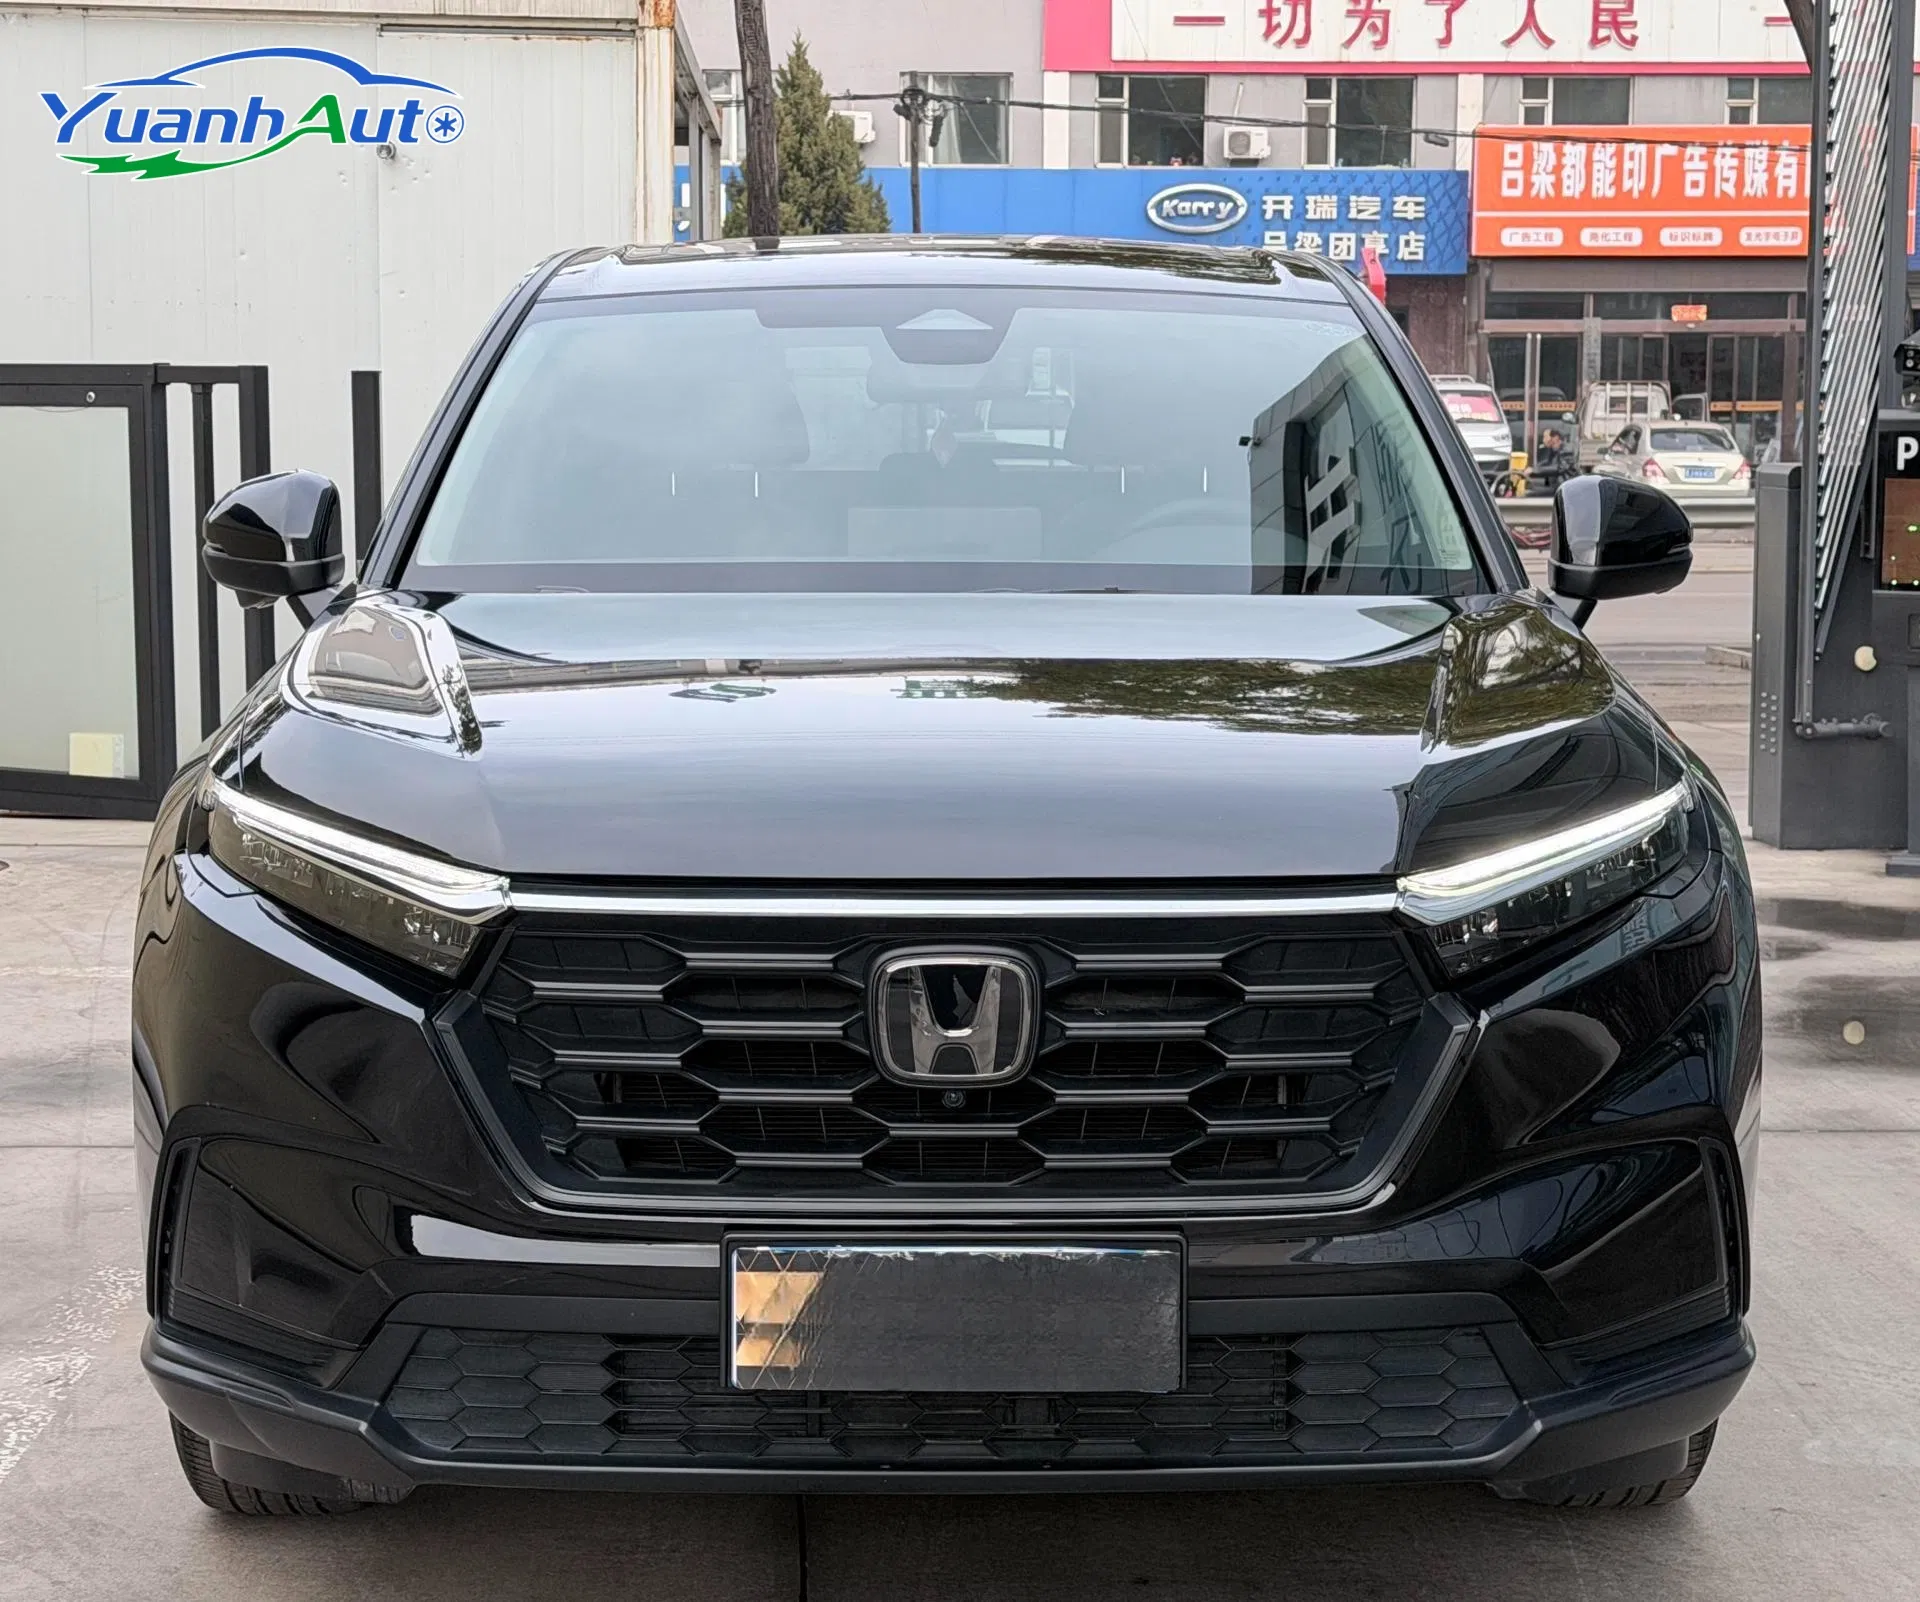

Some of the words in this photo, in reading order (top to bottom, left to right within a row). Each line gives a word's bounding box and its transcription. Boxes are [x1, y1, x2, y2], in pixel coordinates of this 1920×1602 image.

[1501, 140, 1811, 199] 吕梁都能印广告传媒有
[1161, 199, 1234, 219] Karry
[1262, 195, 1426, 220] 开瑞汽车
[1896, 436, 1919, 471] P
